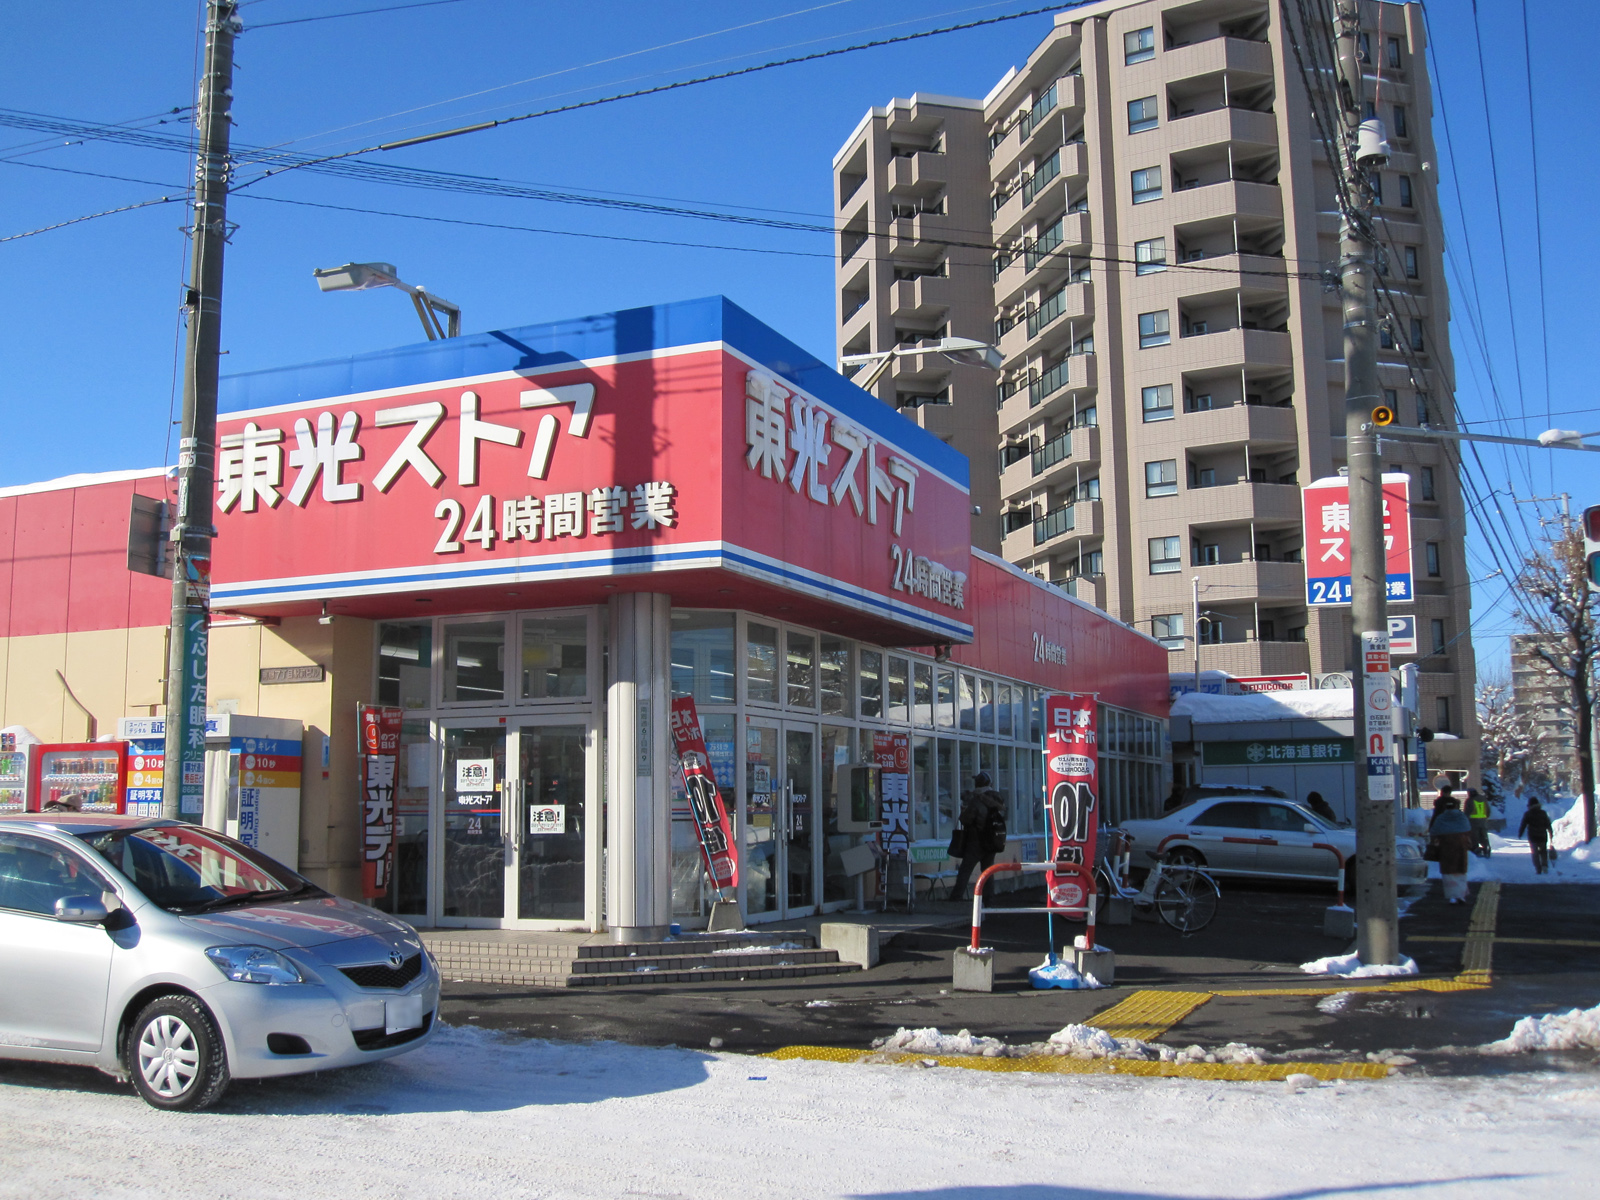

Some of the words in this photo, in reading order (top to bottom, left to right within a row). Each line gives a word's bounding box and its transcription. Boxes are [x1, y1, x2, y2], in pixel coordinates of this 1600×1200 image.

[216, 383, 595, 513] 東光ストア
[745, 369, 919, 537] 東光ストア
[433, 481, 677, 554] 24時間営業
[891, 543, 967, 609] 24時間営業
[1388, 619, 1407, 637] P
[1032, 631, 1067, 667] 24時間営業
[1170, 684, 1222, 695] クリーング
[1249, 683, 1293, 691] FUJICOLOR
[151, 719, 218, 734] 証真
[366, 724, 380, 750] 9
[257, 742, 278, 752] キレイ
[1267, 744, 1342, 759] 北海道銀行
[257, 758, 276, 769] 10秒
[462, 766, 488, 778] 注意!
[130, 790, 162, 800] 証明写真
[458, 795, 493, 805] 東光ストア
[366, 755, 396, 887] 東光デー
[468, 817, 482, 830] 24
[533, 811, 560, 823] 注意!
[796, 814, 803, 825] 24
[916, 849, 948, 860] FUJICOLOR
